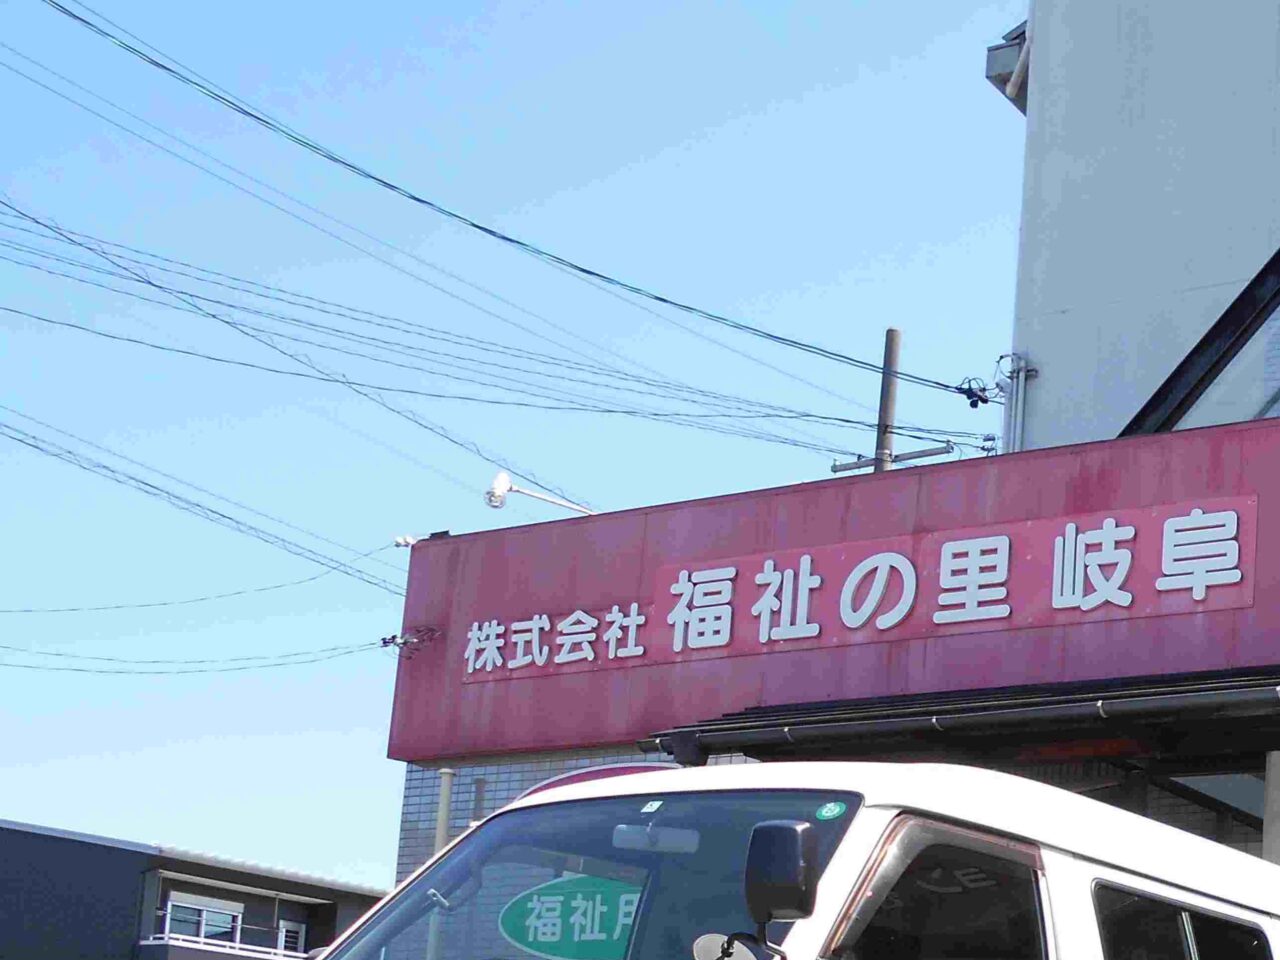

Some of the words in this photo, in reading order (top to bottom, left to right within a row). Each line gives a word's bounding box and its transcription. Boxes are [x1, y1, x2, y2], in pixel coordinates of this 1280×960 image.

[463, 602, 647, 674] 株式会社
[667, 534, 1012, 653] 福祉の里
[1052, 509, 1243, 612] 岐阜
